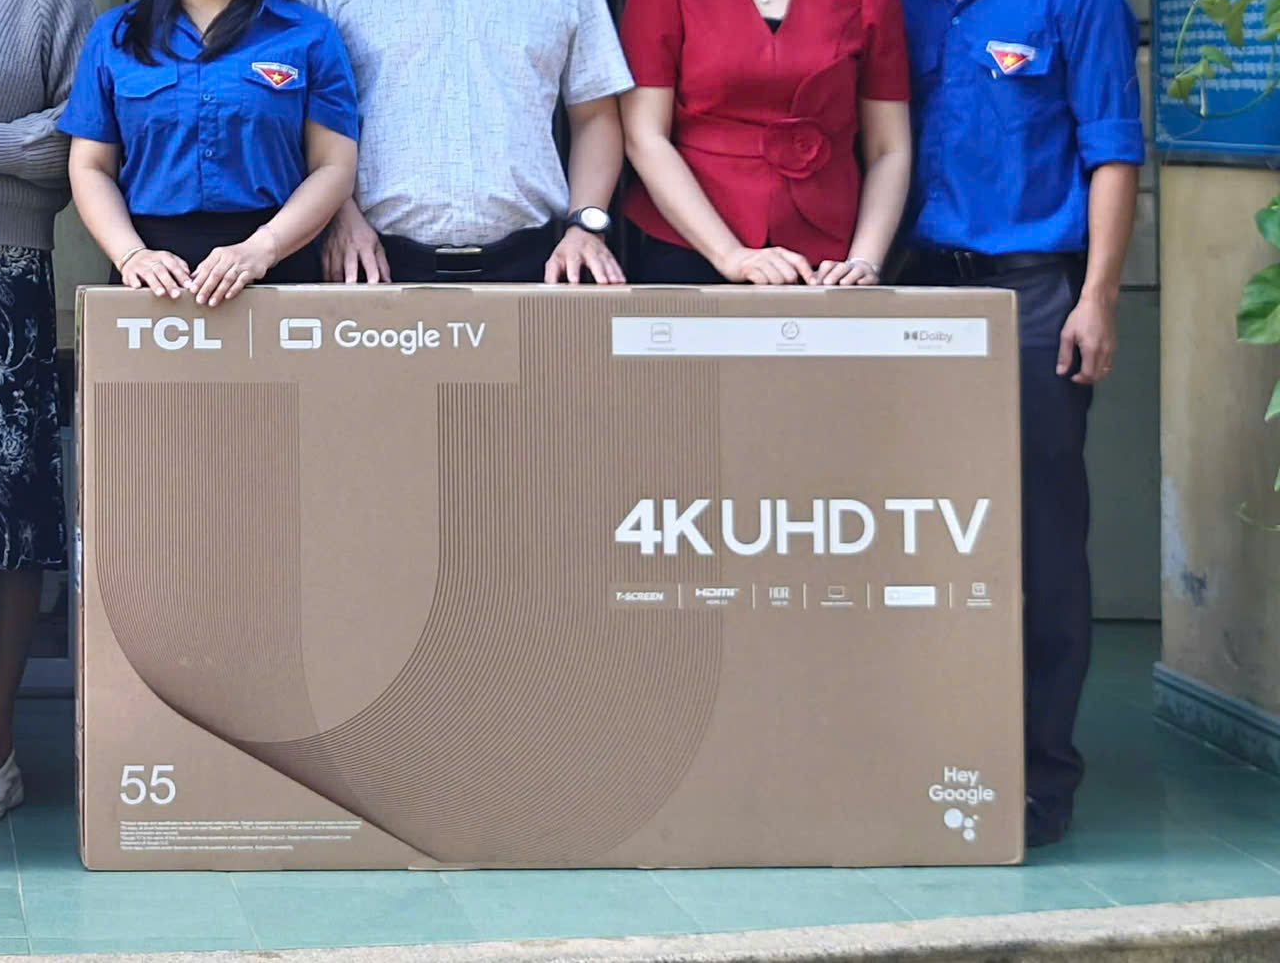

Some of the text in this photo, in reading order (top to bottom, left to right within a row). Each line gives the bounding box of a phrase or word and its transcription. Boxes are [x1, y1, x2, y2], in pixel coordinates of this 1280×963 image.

[116, 316, 222, 351] TCL
[333, 320, 486, 356] Google TV
[615, 498, 991, 556] 4K UHD TV
[615, 591, 665, 602] T-SCREEN
[119, 764, 177, 806] 55
[943, 766, 981, 787] Hey
[928, 784, 994, 805] Google
